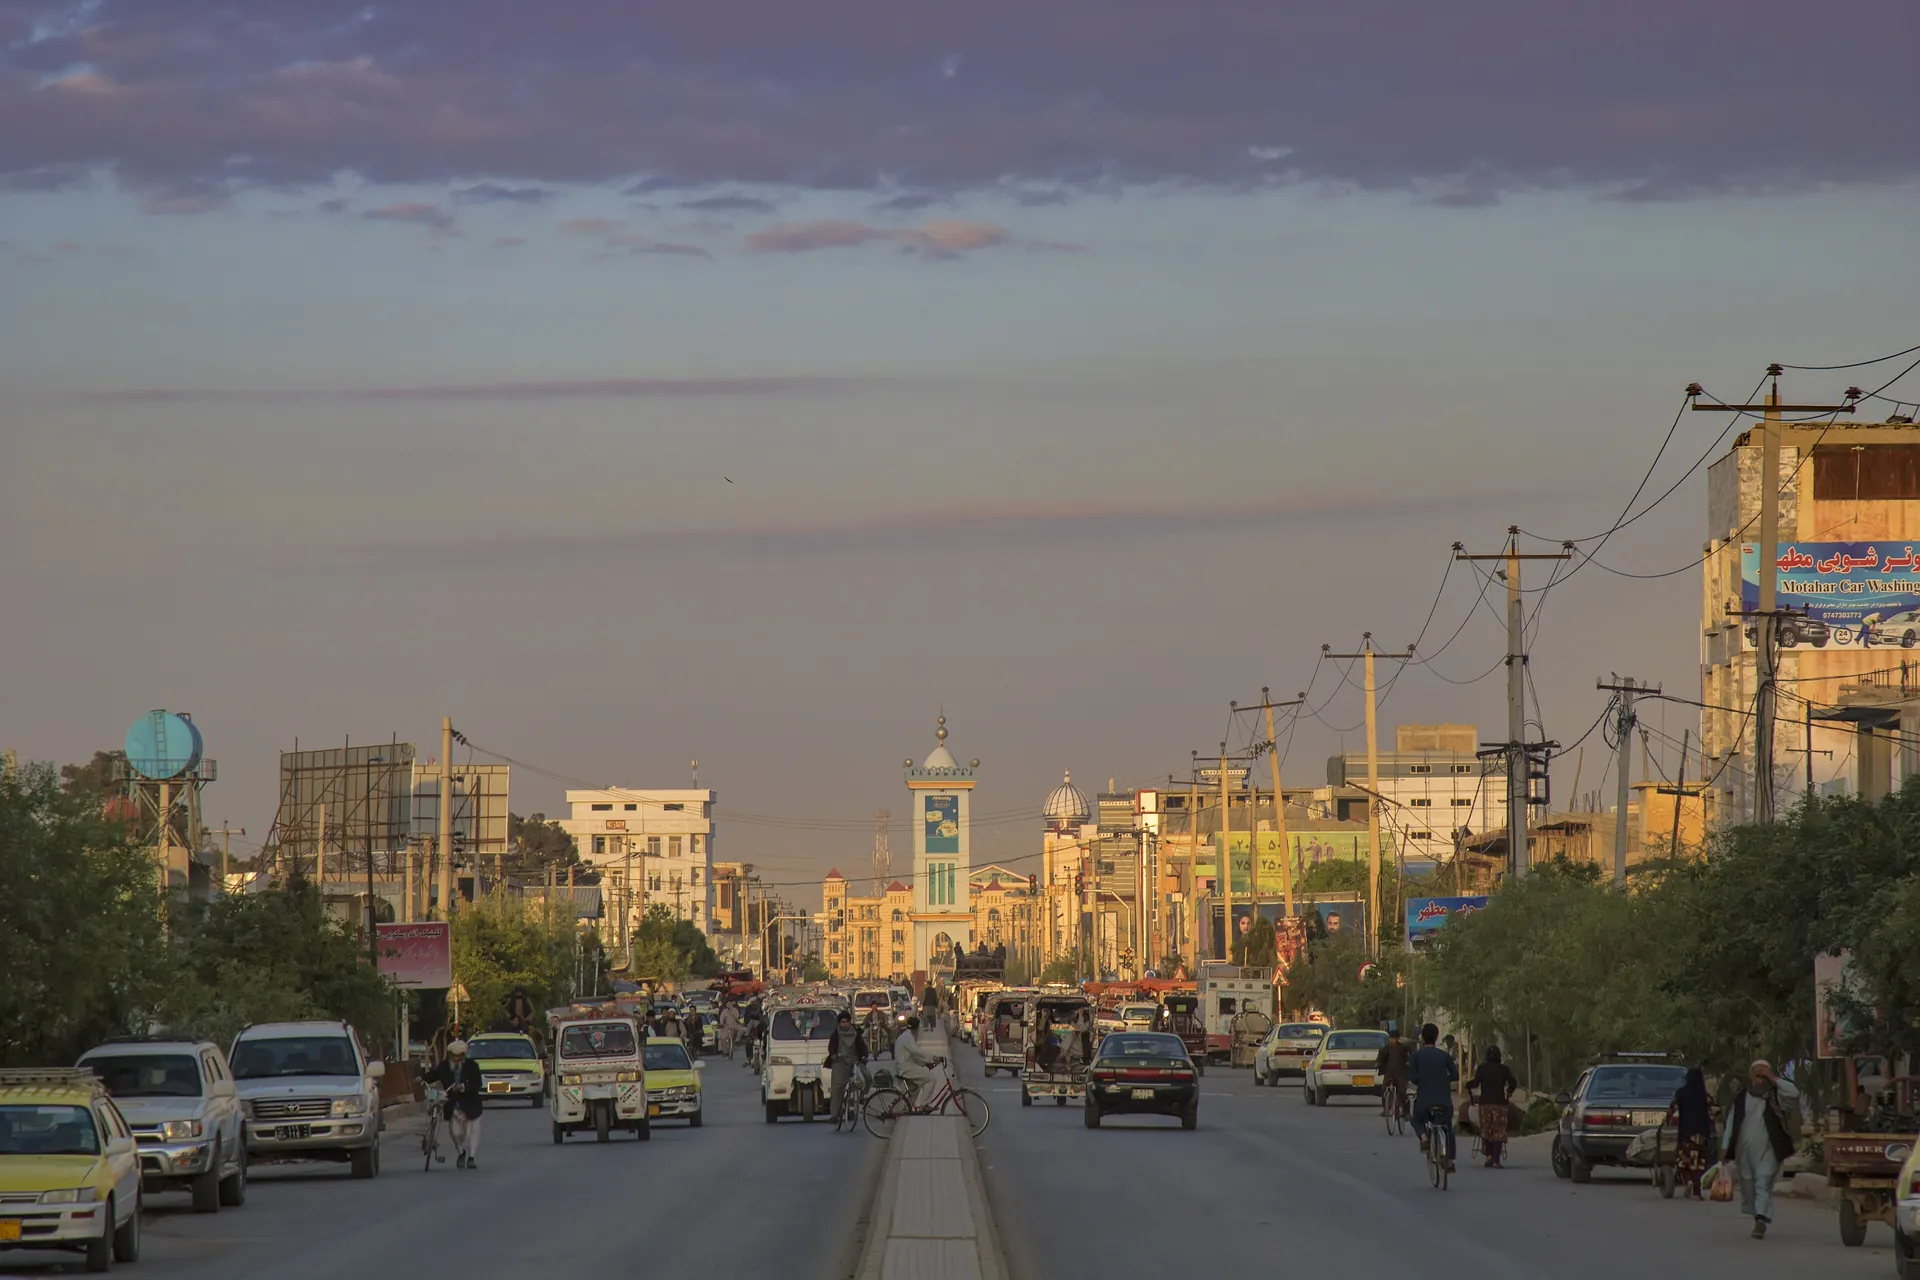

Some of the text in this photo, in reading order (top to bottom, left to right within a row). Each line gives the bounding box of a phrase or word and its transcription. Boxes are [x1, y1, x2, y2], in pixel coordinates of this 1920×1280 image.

[1757, 546, 1813, 573] مطه
[1781, 578, 1920, 595] Motahar Car Washing
[1416, 901, 1447, 922] مطهر
